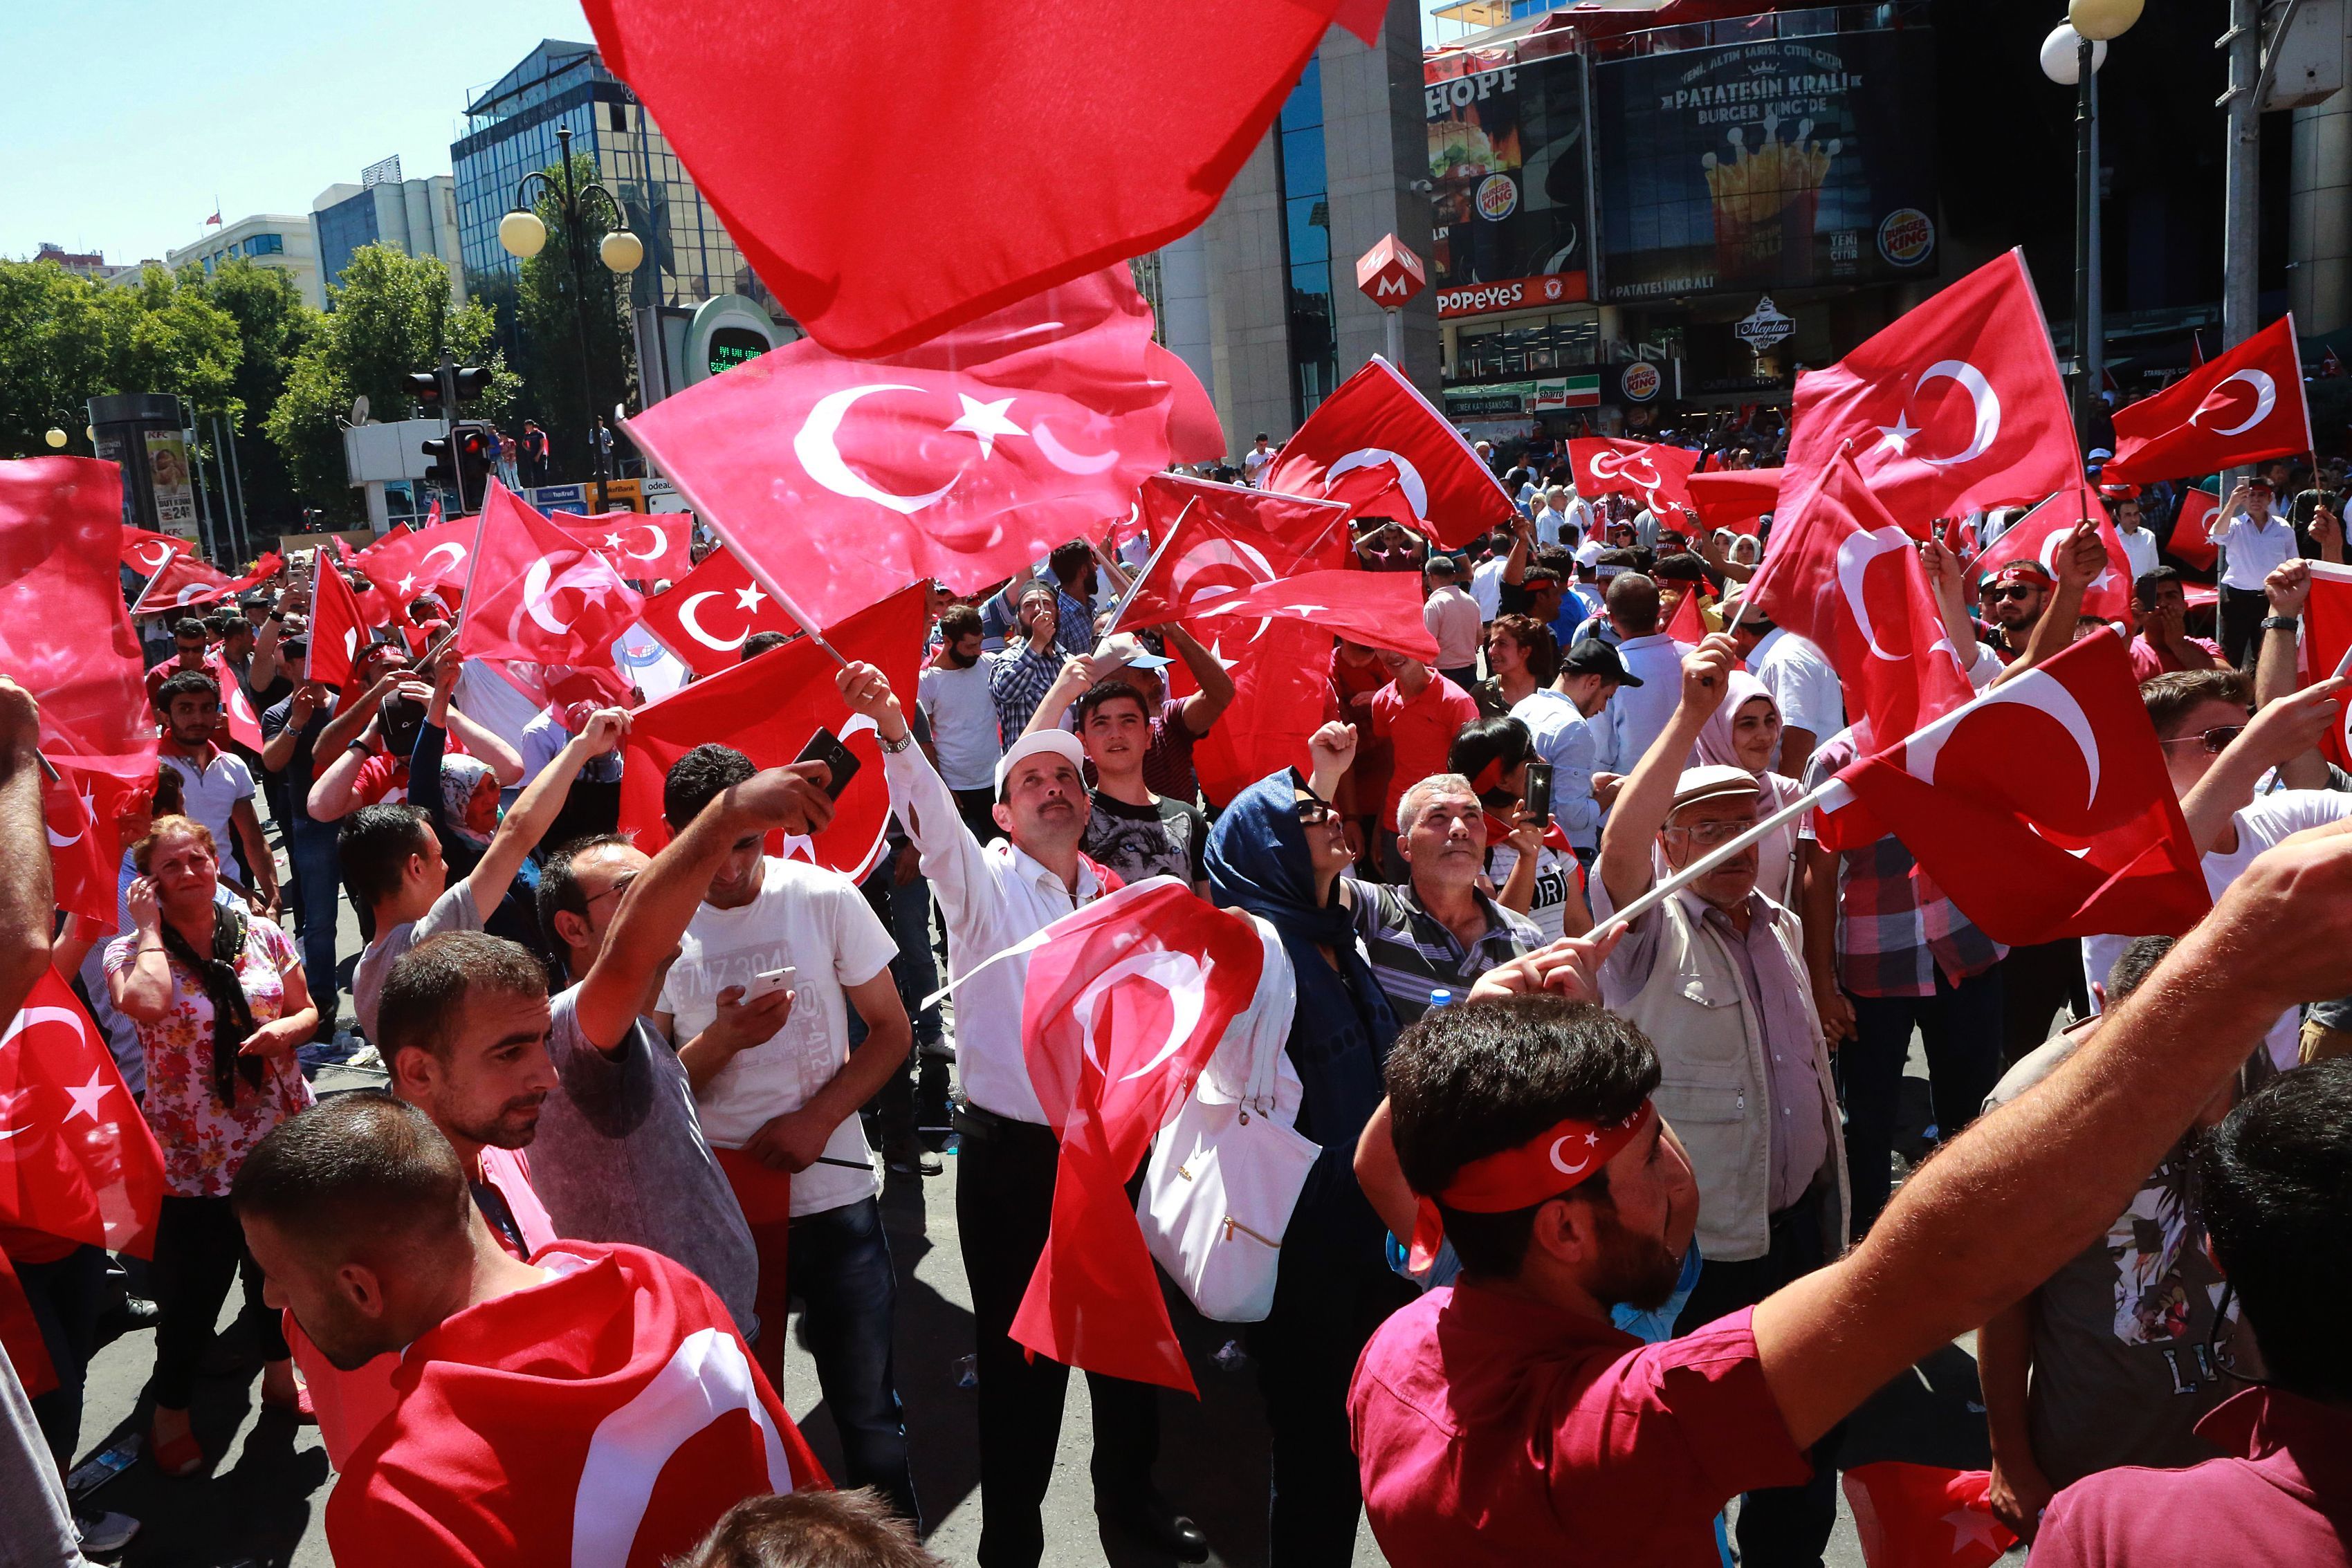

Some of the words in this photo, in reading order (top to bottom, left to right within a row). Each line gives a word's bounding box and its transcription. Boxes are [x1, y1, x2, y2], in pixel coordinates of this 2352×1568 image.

[1675, 76, 1782, 109] PATATESİN
[1789, 72, 1848, 95] KRALI
[1698, 104, 1759, 124] BURGER
[1482, 182, 1510, 203] BURGER
[1483, 189, 1513, 212] KING
[1885, 219, 1927, 241] BURGER
[1888, 228, 1929, 255] KING
[1377, 274, 1408, 297] M
[1741, 321, 1790, 338] Meydan
[1627, 370, 1655, 383] BURGER
[1628, 376, 1656, 392] KING
[1539, 390, 1564, 399] sbarro
[148, 431, 168, 439] KFC
[172, 506, 187, 519] 24
[164, 528, 183, 536] KFC
